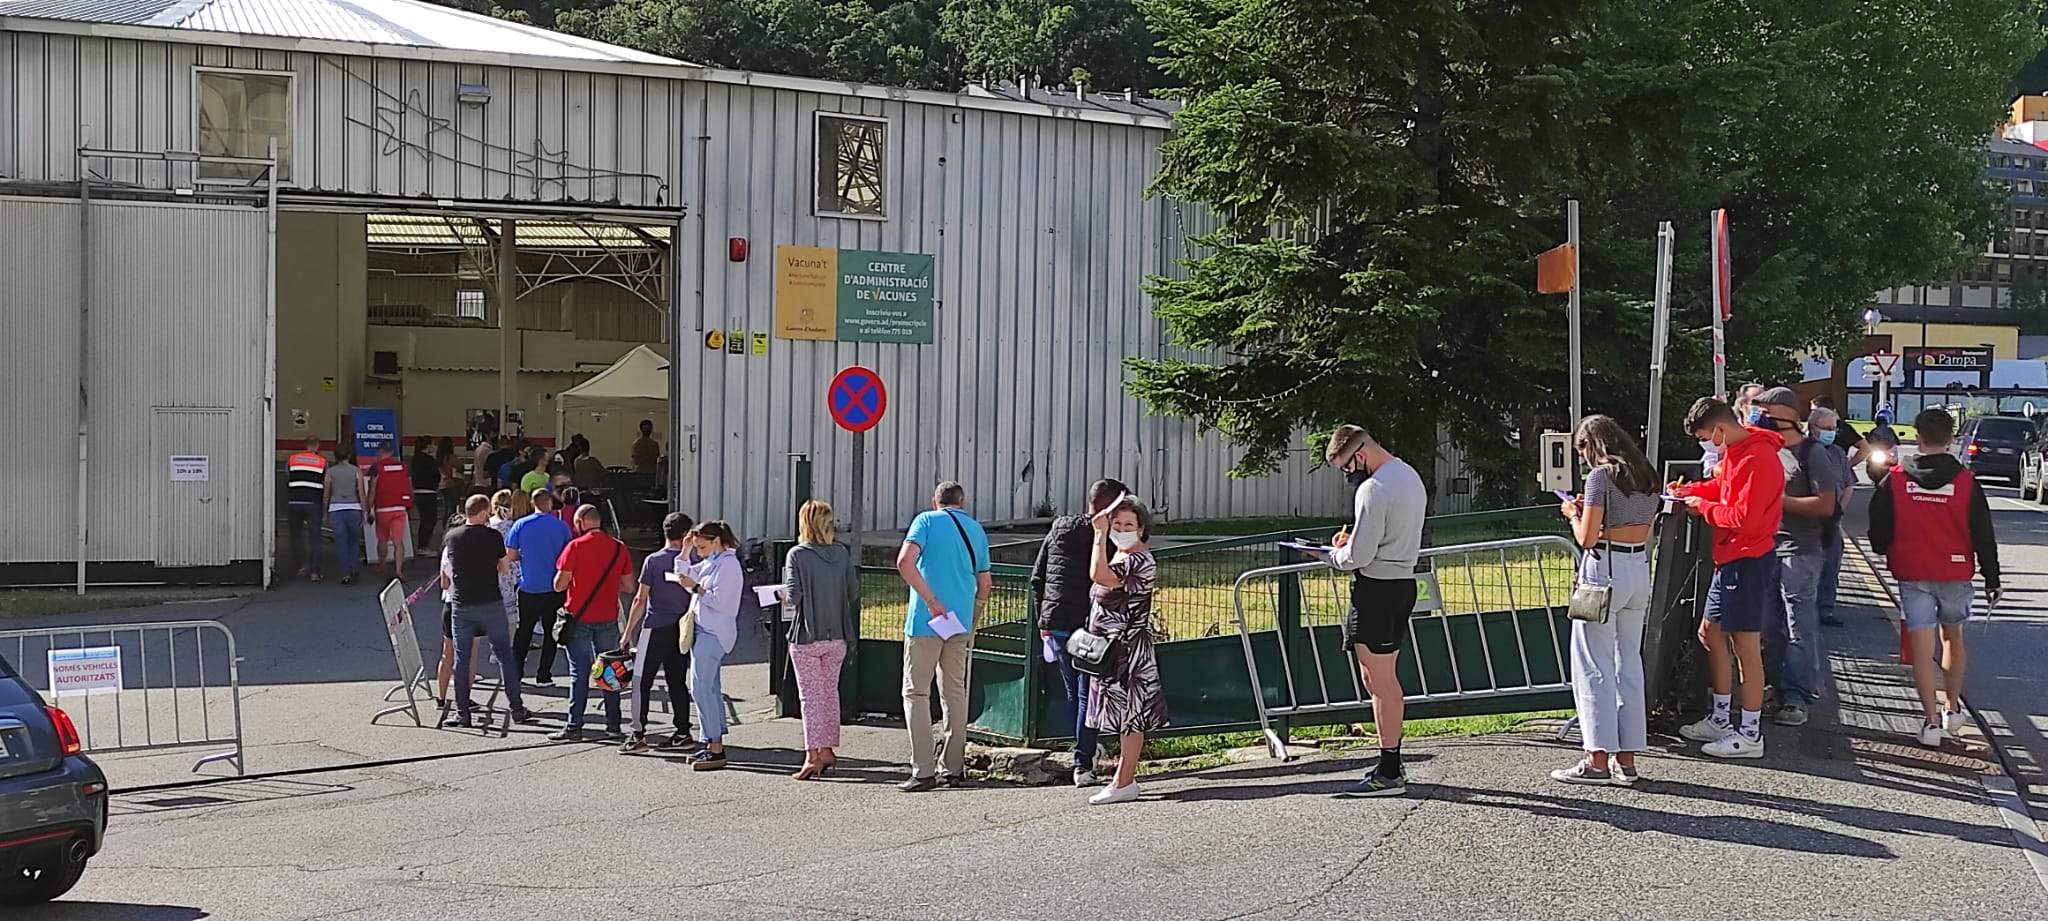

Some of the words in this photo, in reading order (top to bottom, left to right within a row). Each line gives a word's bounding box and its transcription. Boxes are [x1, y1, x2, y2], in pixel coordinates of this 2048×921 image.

[787, 257, 827, 269] Vacuna't
[868, 262, 906, 273] CENTRE
[844, 274, 928, 288] D'ADMINISTRACIÓ
[856, 290, 870, 300] DE
[872, 287, 917, 302] VACUNES
[1939, 354, 1977, 367] Pampa
[82, 662, 118, 671] VEHICLES
[56, 673, 116, 684] AUTORITZATS
